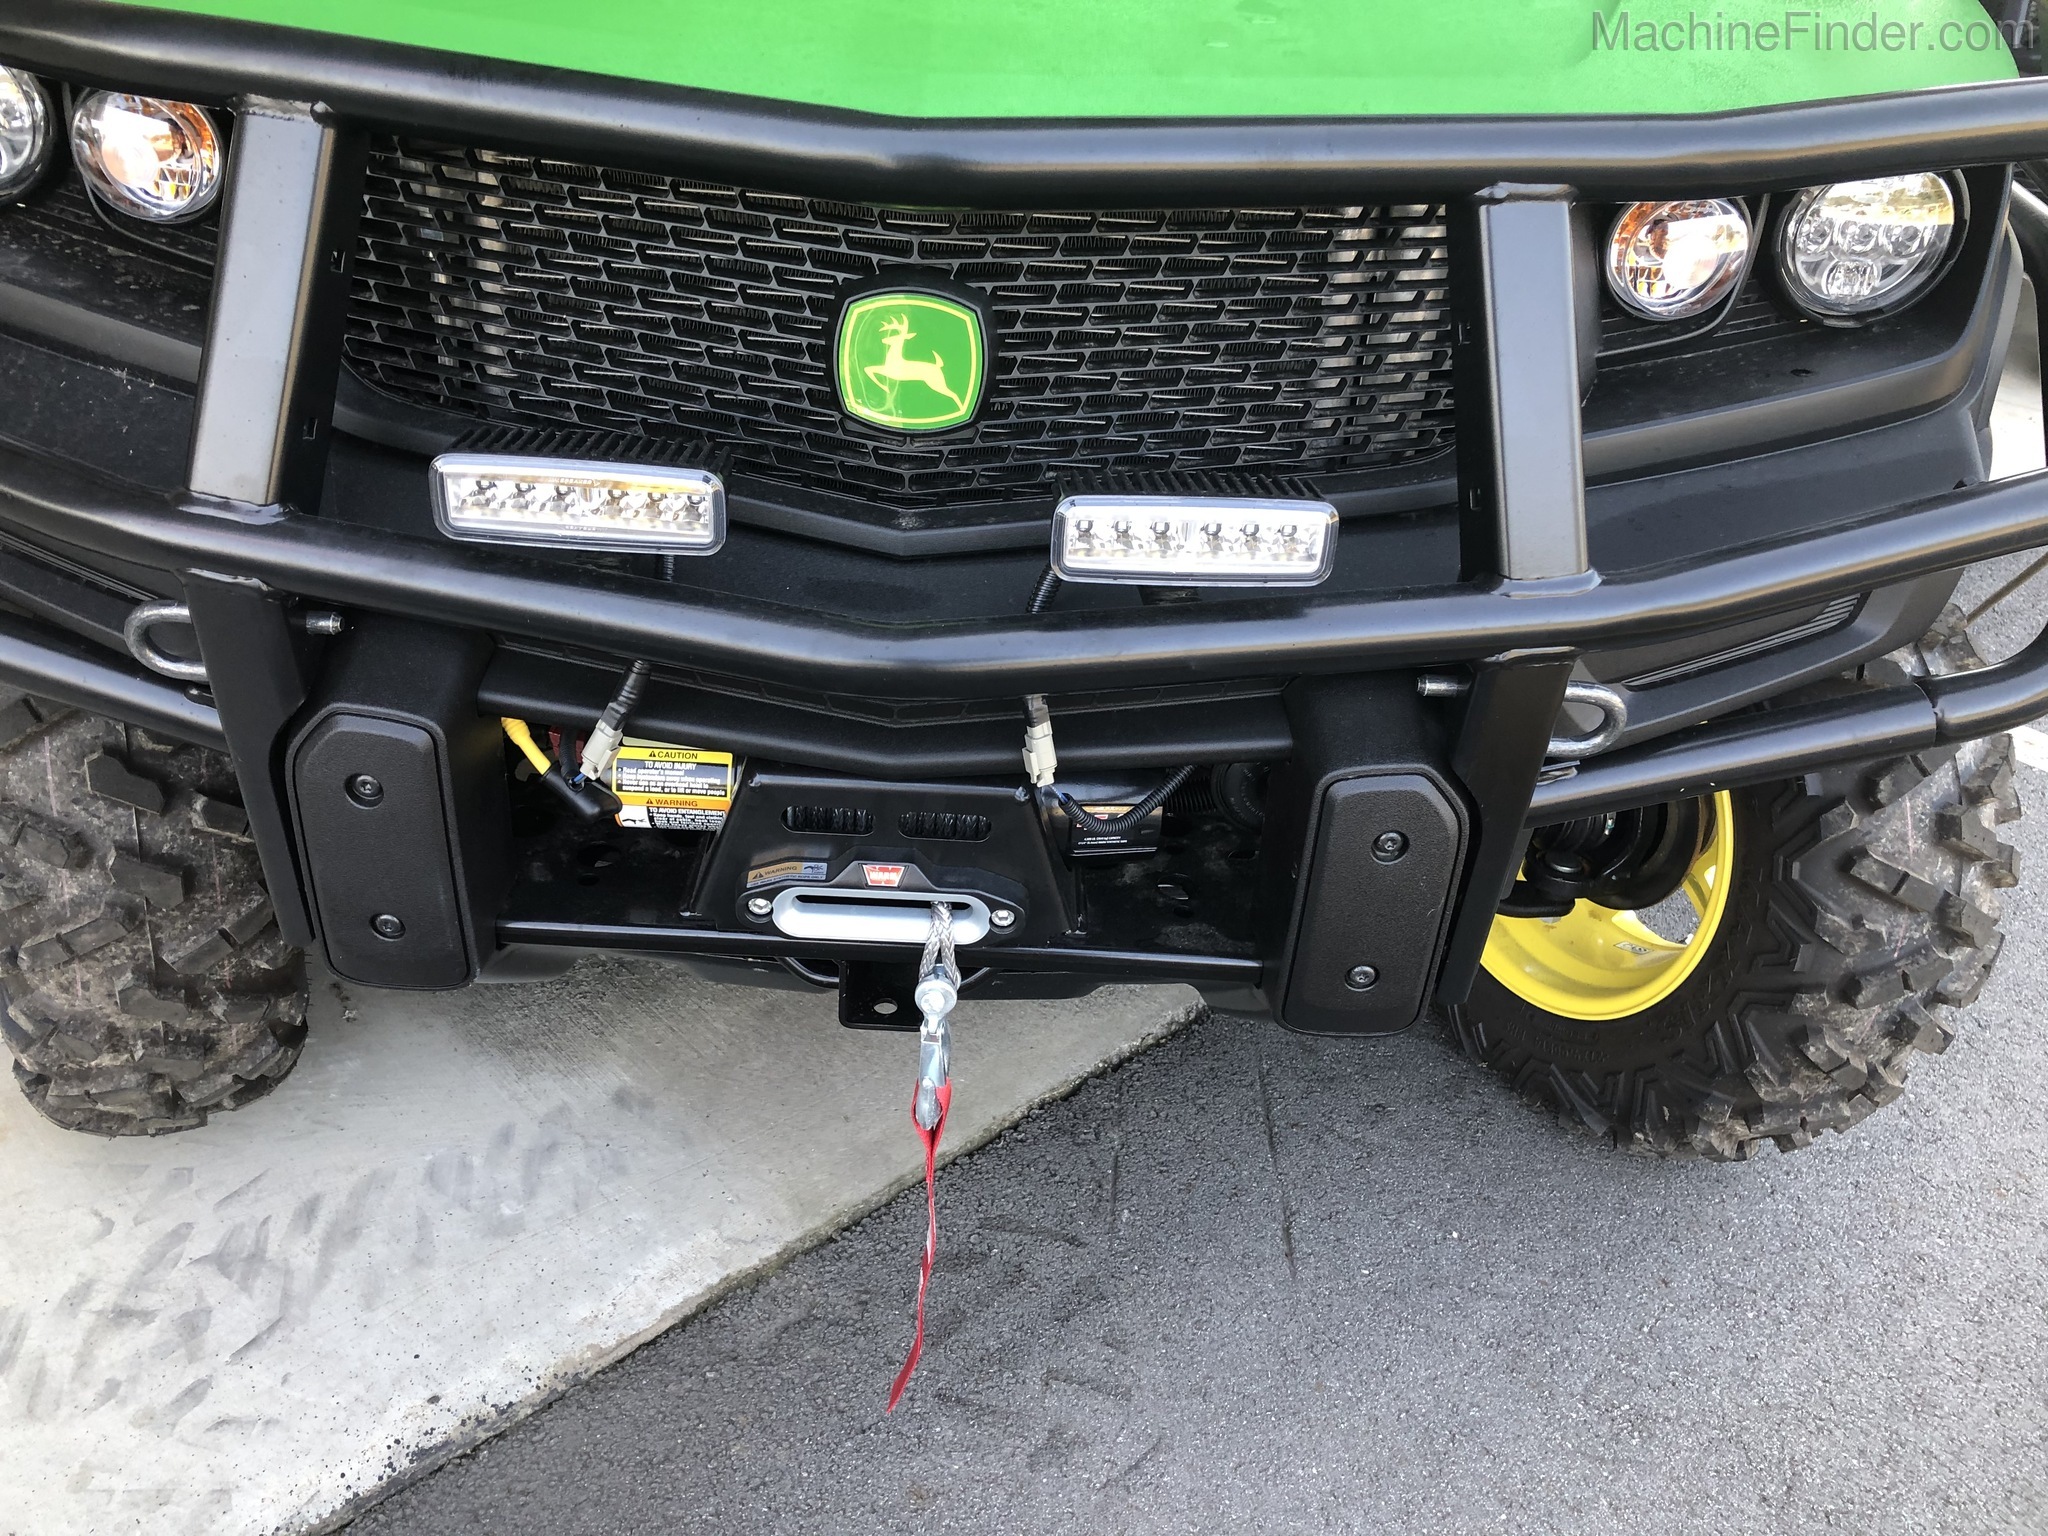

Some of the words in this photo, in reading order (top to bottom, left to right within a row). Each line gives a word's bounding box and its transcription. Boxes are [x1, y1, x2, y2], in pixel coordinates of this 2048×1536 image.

[657, 750, 698, 760] CAUTION
[654, 761, 673, 770] AVOID
[673, 762, 697, 771] INJURY
[655, 798, 698, 807] WARNING
[764, 865, 798, 876] WARNING
[869, 871, 898, 881] WARN
